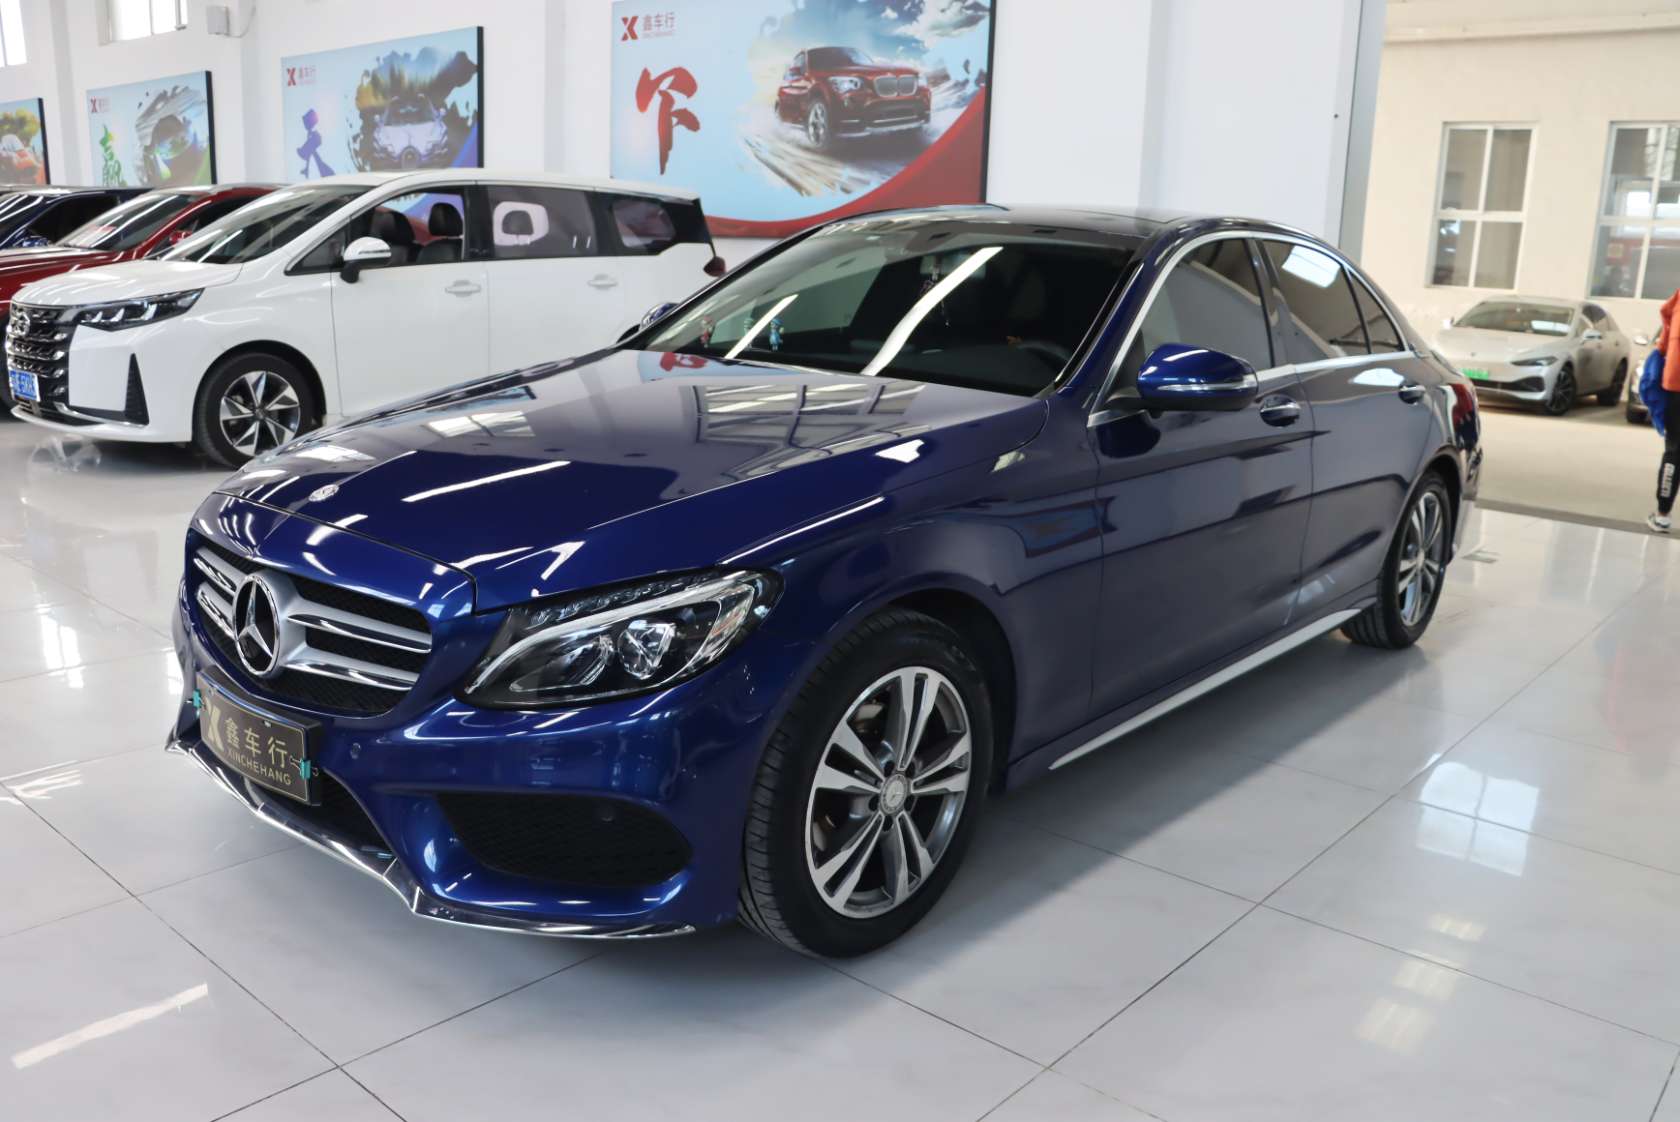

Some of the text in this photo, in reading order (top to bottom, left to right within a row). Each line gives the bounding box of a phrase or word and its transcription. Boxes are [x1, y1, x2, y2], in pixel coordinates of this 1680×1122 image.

[224, 717, 288, 769] 鑫车行
[227, 750, 292, 786] XINCHEHANG
